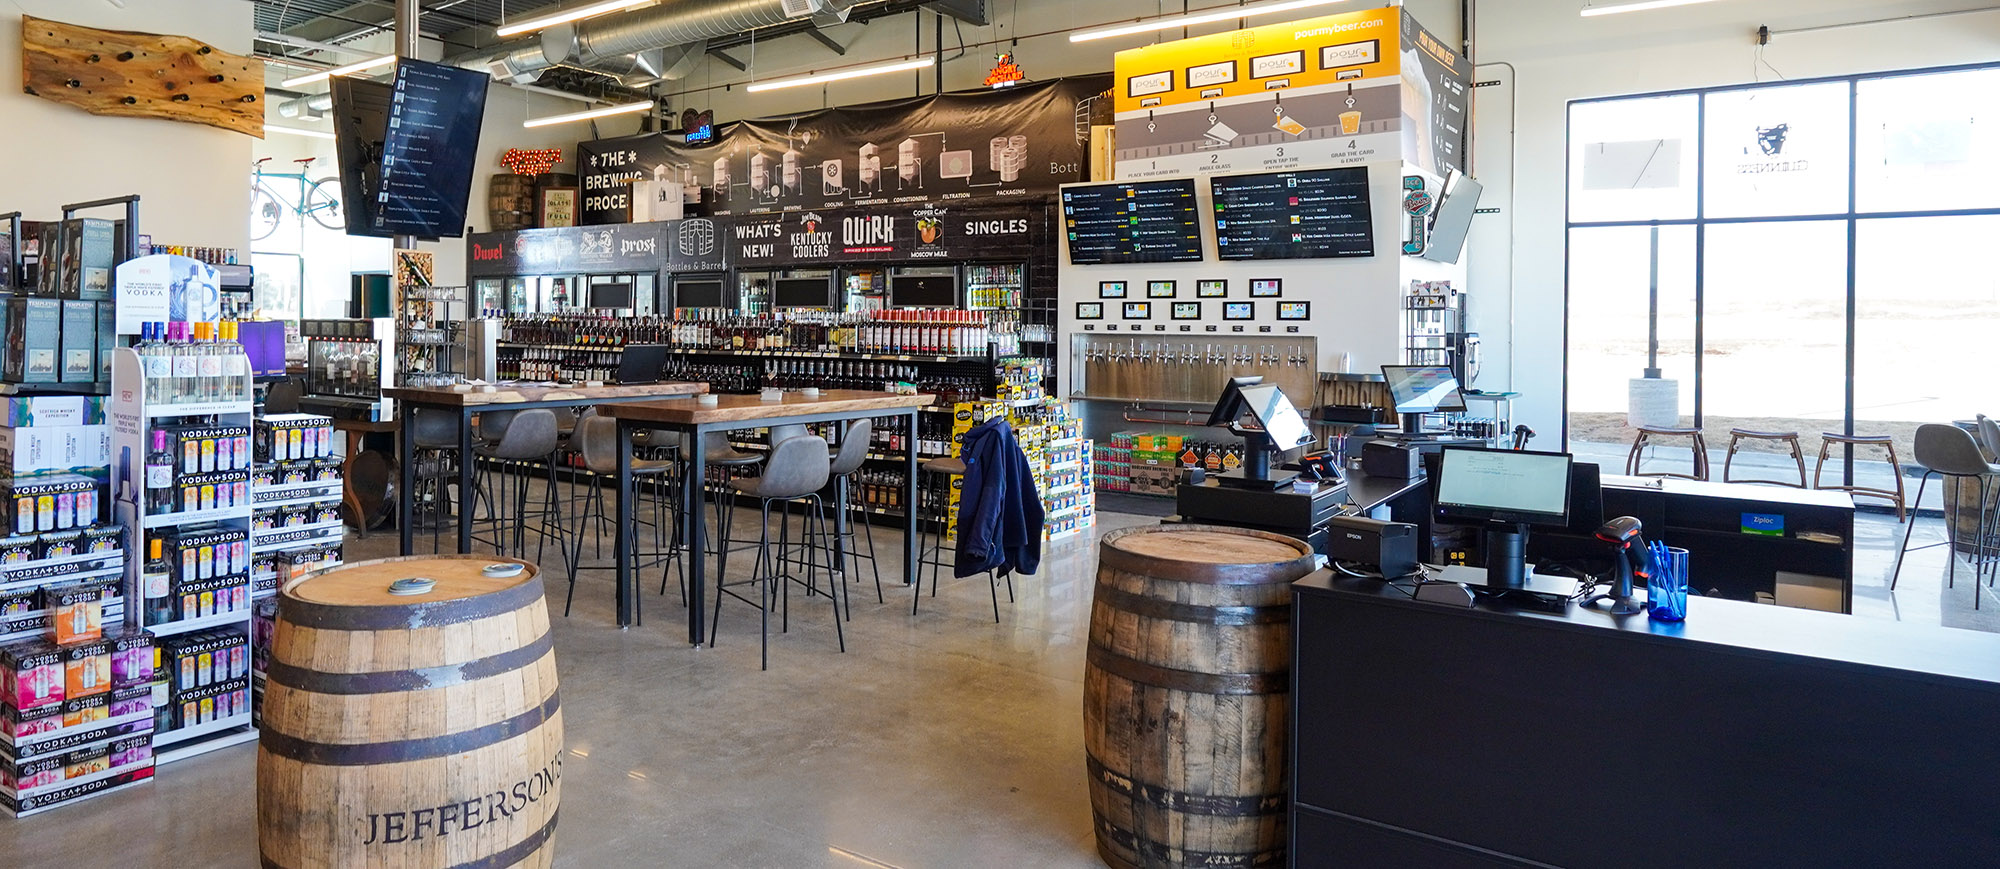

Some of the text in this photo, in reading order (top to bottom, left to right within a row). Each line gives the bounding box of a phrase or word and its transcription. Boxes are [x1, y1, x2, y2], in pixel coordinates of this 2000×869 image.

[1294, 17, 1384, 41] pourmybeer.com
[1444, 51, 1455, 67] BEER
[990, 64, 1018, 77] ANGRY
[984, 70, 1024, 86] ORCHARD
[1347, 140, 1357, 149] 4
[501, 148, 564, 167] APEROL
[1276, 147, 1284, 157] 3
[601, 151, 625, 167] THE
[1151, 161, 1156, 170] 1
[1211, 154, 1218, 164] 2
[1050, 162, 1079, 175] Bott
[893, 195, 928, 203] CONDITIONING
[942, 192, 970, 200] FILTRATION
[996, 188, 1026, 197] PACKAGING
[586, 194, 629, 211] PROCE
[855, 198, 888, 206] FERMENTATION
[913, 209, 933, 217] COPPER
[735, 223, 782, 239] WHAT'S
[965, 219, 1028, 236] SINGLES
[790, 231, 833, 246] KENTUCKY
[473, 243, 503, 261] Duvel
[621, 237, 656, 256] prost
[743, 245, 774, 258] NEW!
[793, 245, 829, 258] COOLERS
[667, 262, 691, 271] Bottles
[701, 262, 727, 270] Barrels
[272, 419, 331, 428] VODKA+SODA
[181, 428, 248, 438] VODKA+SODA
[181, 472, 247, 484] VODKA+SODA
[14, 481, 94, 495] VODKA+SODA
[257, 489, 310, 499] VODKA+SODA
[1753, 516, 1774, 525] Ziploc
[179, 532, 245, 547] VODKA+SODA
[257, 531, 310, 542] VODKA+SODA
[10, 563, 80, 579] VODKA+SODA
[180, 576, 246, 593] VODKA+SODA
[178, 636, 245, 655] VODKA+SODA
[180, 680, 246, 700] VODKA+SODA
[35, 729, 108, 751] VODKA+SODA
[37, 780, 108, 802] VODKA+SODA
[363, 749, 563, 846] JEFFERSON'S
